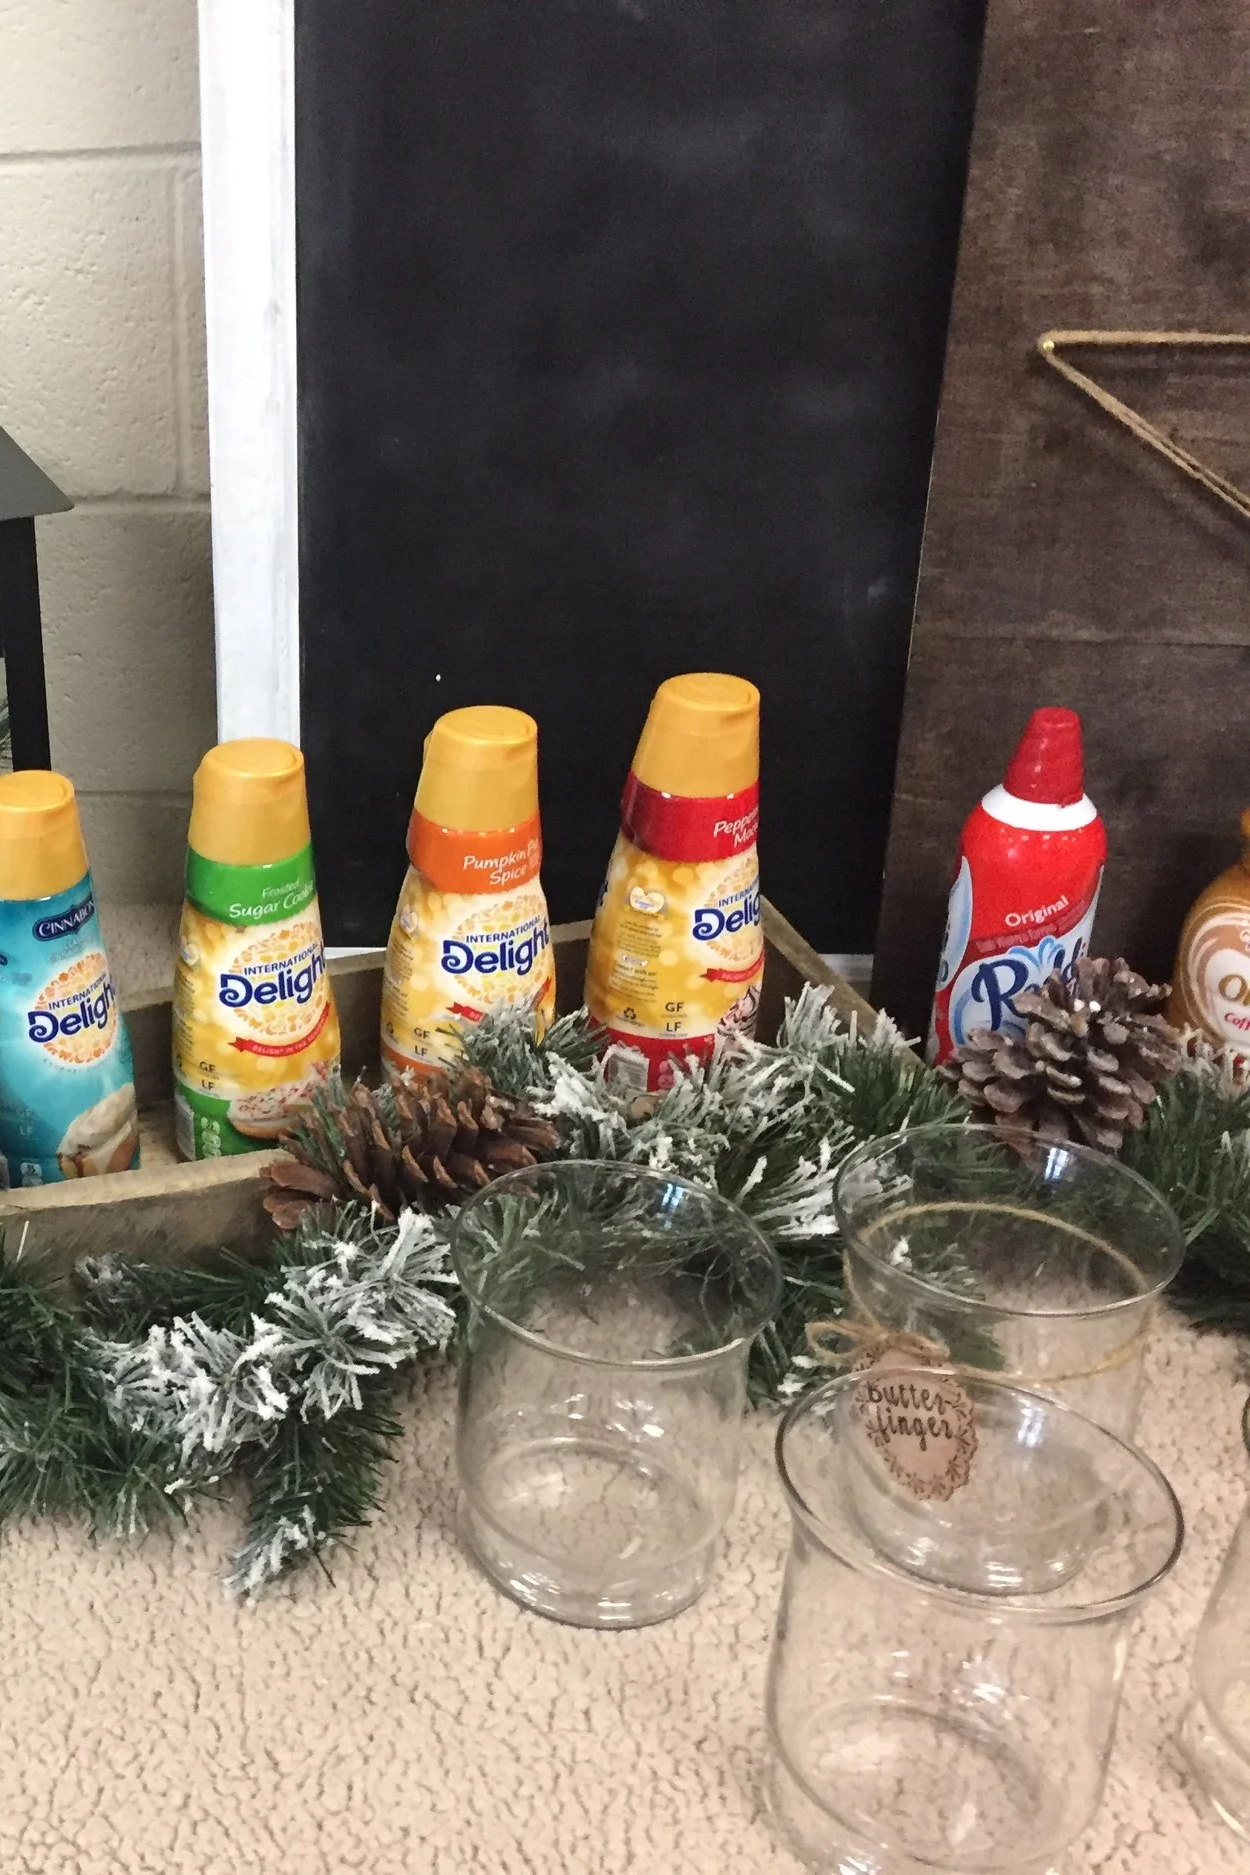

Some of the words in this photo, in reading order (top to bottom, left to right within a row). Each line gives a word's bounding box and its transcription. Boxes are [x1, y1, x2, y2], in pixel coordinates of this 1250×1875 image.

[464, 849, 527, 873] Pumpkin
[490, 864, 527, 886] Spice
[229, 903, 281, 919] Sugar
[1005, 895, 1069, 927] Original
[466, 915, 542, 943] INTERNATIONAL
[441, 917, 549, 976] Delight
[665, 1002, 684, 1012] GF
[414, 1027, 431, 1039] GF
[666, 1022, 682, 1032] LF
[415, 1045, 428, 1056] LF
[876, 1406, 953, 1451] finger
